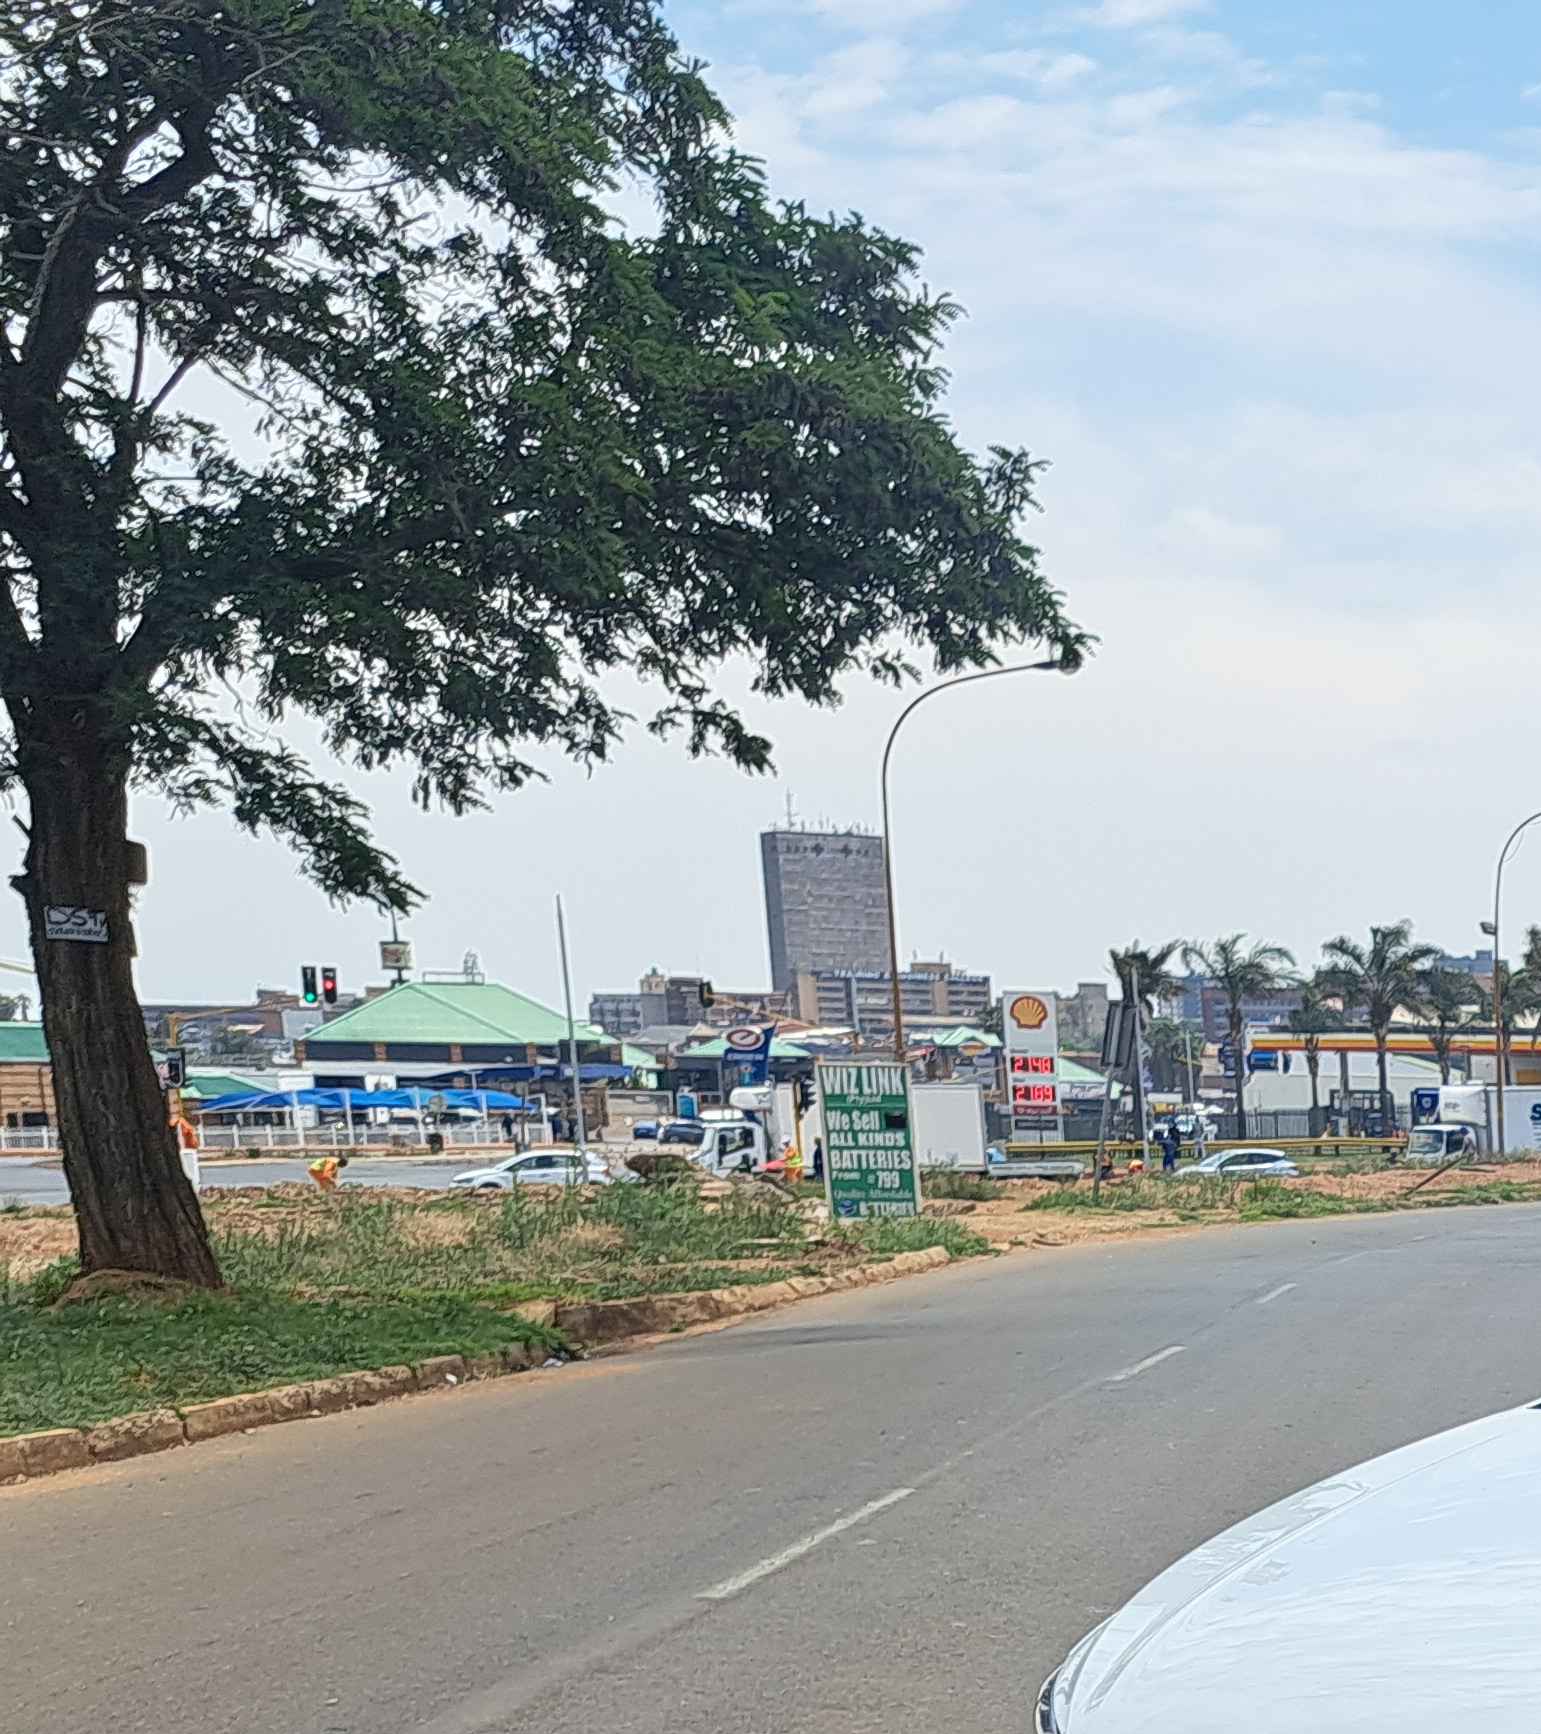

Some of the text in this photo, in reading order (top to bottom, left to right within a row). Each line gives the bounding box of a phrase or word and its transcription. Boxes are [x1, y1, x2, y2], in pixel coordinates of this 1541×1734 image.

[822, 1066, 905, 1096] WIZ LINK
[826, 1109, 880, 1131] We Sell
[829, 1131, 906, 1147] ALL KINDS
[830, 1149, 912, 1170] BATTERIES
